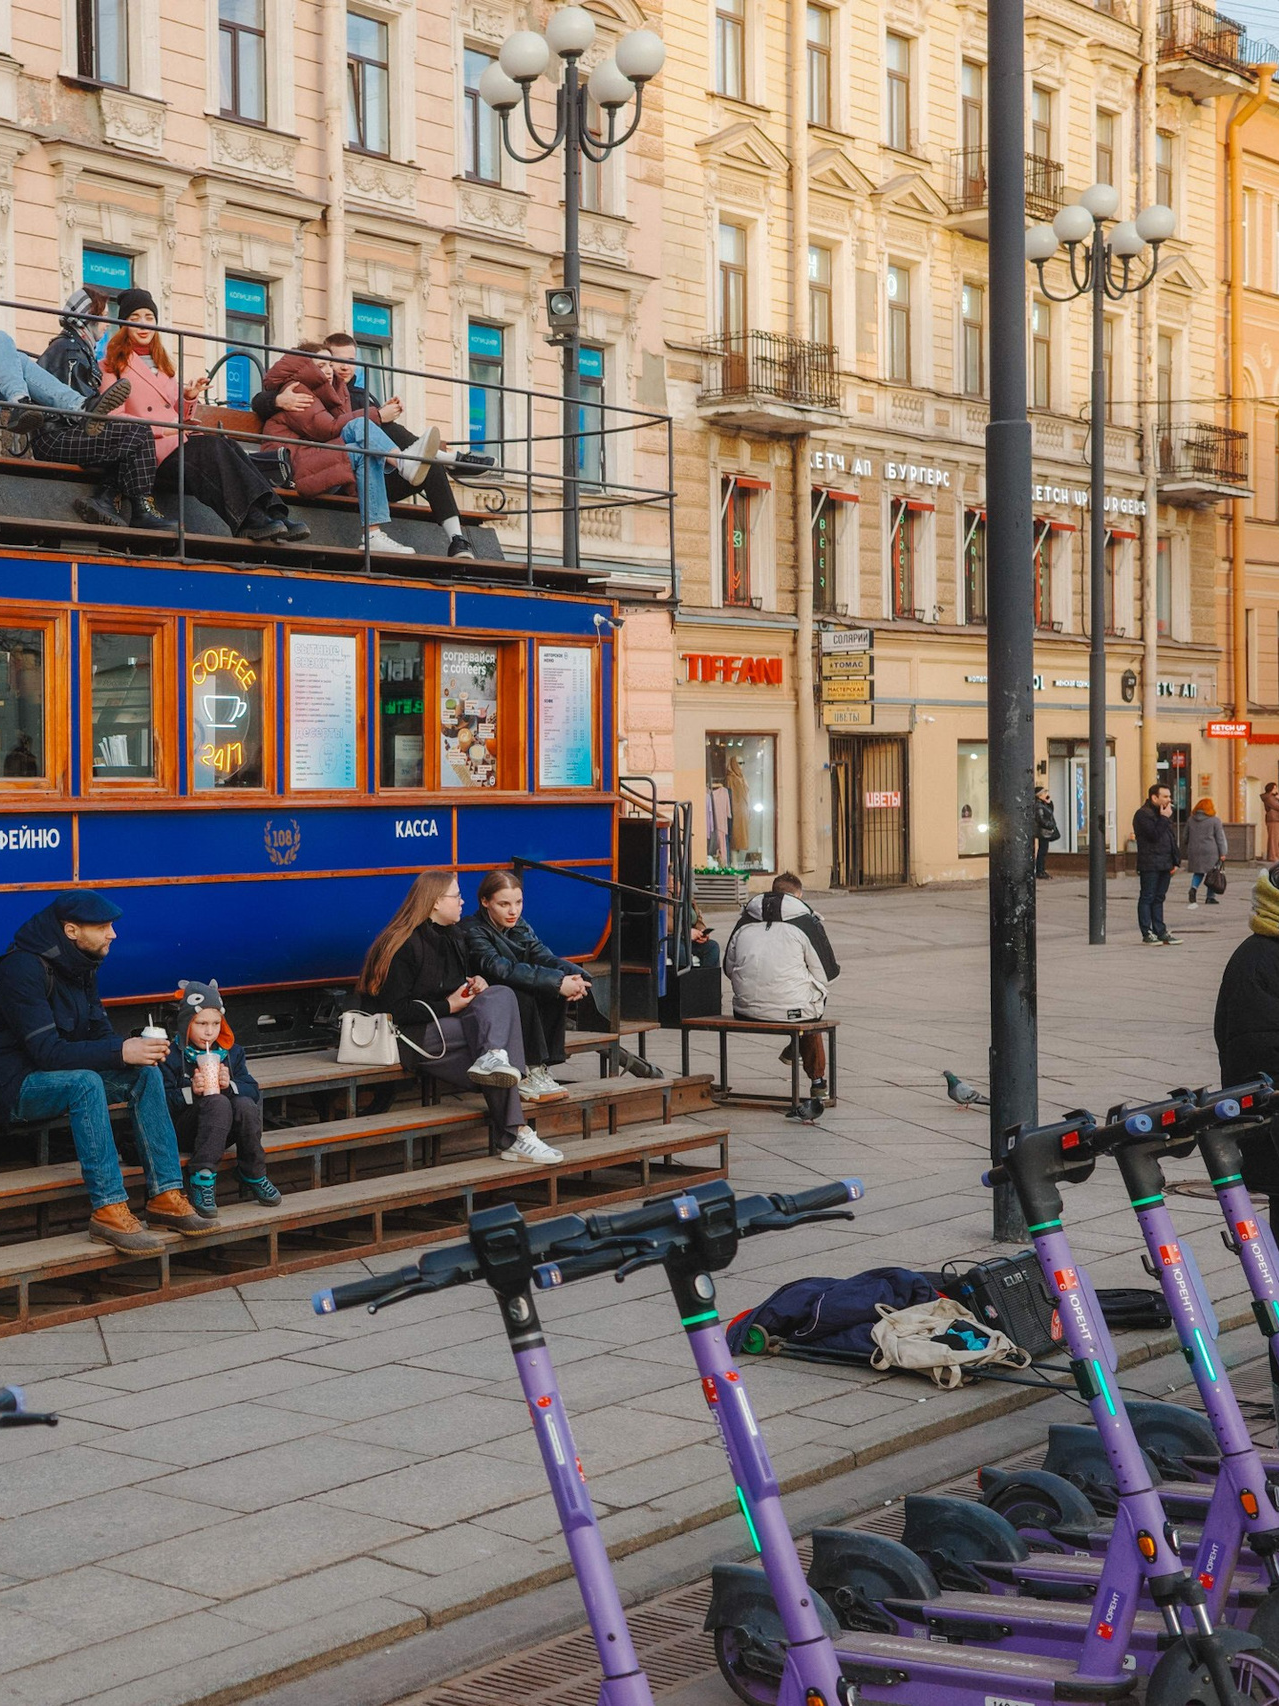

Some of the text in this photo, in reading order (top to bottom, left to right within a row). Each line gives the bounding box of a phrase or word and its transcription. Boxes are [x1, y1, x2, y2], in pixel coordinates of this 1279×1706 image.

[852, 458, 872, 477] АП
[887, 462, 950, 487] БУРГЕРС
[1074, 490, 1088, 506] UP
[1090, 496, 1147, 515] URGERS
[833, 631, 868, 645] СОЛЯРИЙ
[442, 650, 496, 664] согревайся
[834, 661, 864, 669] ТОМАС
[191, 647, 257, 692] COFFEE
[450, 662, 487, 675] coffeers
[1181, 684, 1197, 698] АП
[834, 712, 860, 723] ЦВЕТЫ
[866, 791, 901, 808] ЦВЕТЫ
[395, 819, 439, 838] КАССА
[273, 830, 292, 847] 108
[1251, 1243, 1273, 1285] ЮРЕНТ
[1003, 1270, 1030, 1287] CUBE
[1173, 1268, 1194, 1313] ЮРЕНТ
[1069, 1294, 1093, 1341] ЮРЕНТ
[1206, 1543, 1220, 1574] ЮРЕНТ
[1105, 1592, 1121, 1624] ЮРЕНТ
